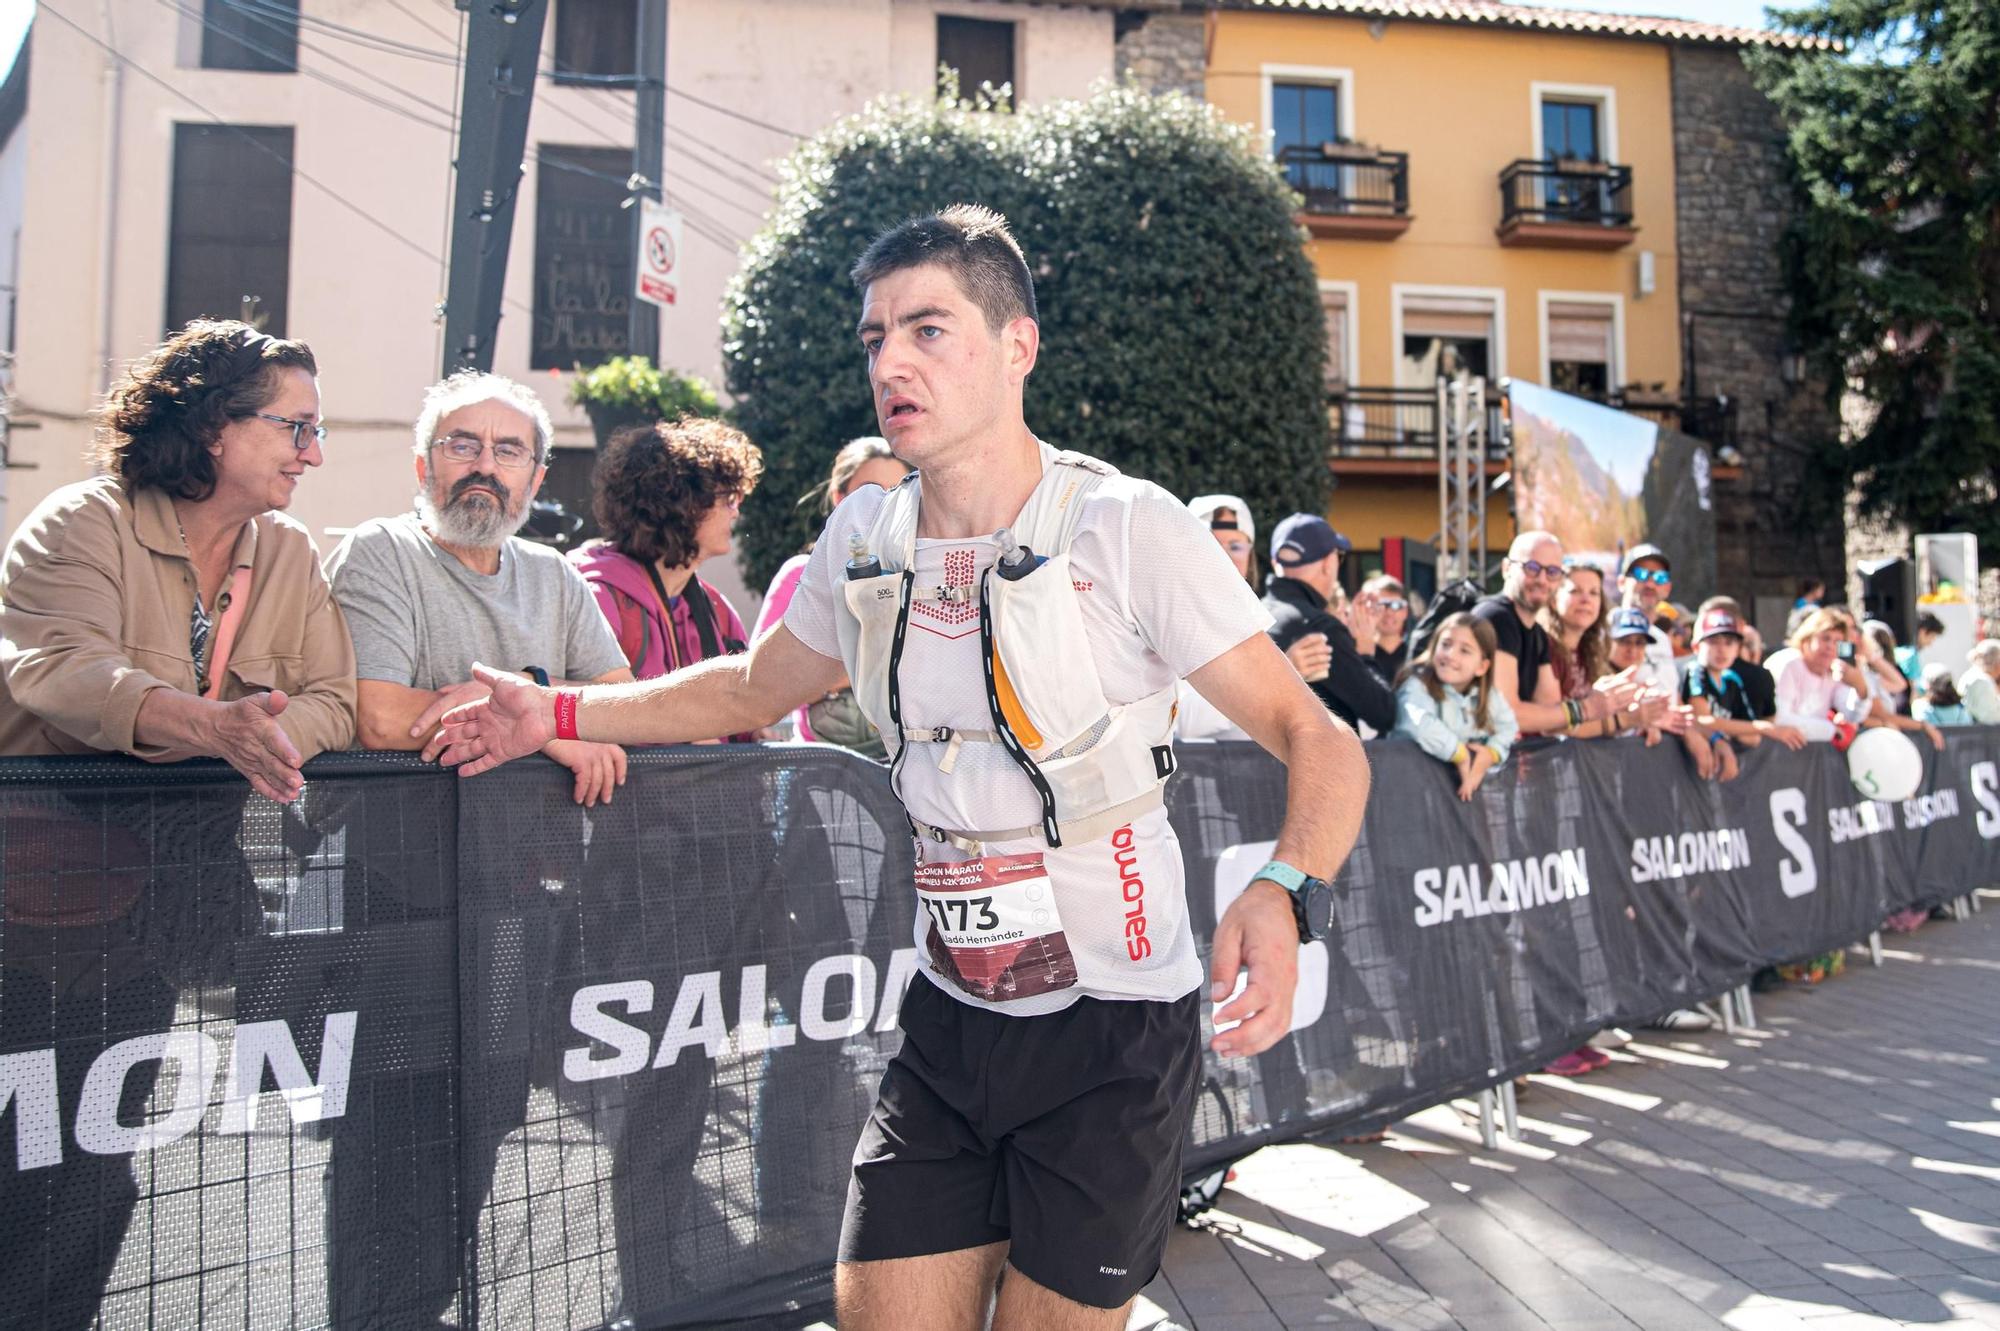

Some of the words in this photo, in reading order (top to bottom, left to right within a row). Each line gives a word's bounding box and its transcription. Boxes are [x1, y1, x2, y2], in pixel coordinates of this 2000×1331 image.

[561, 692, 572, 729] PARTIC
[1631, 828, 1751, 883] SALOMON
[1769, 787, 1817, 898] S
[944, 862, 984, 875] MARATÓ
[1414, 847, 1590, 927] SALOMON
[966, 930, 1024, 944] Hernández
[1100, 1265, 1127, 1275] KIPRUN
